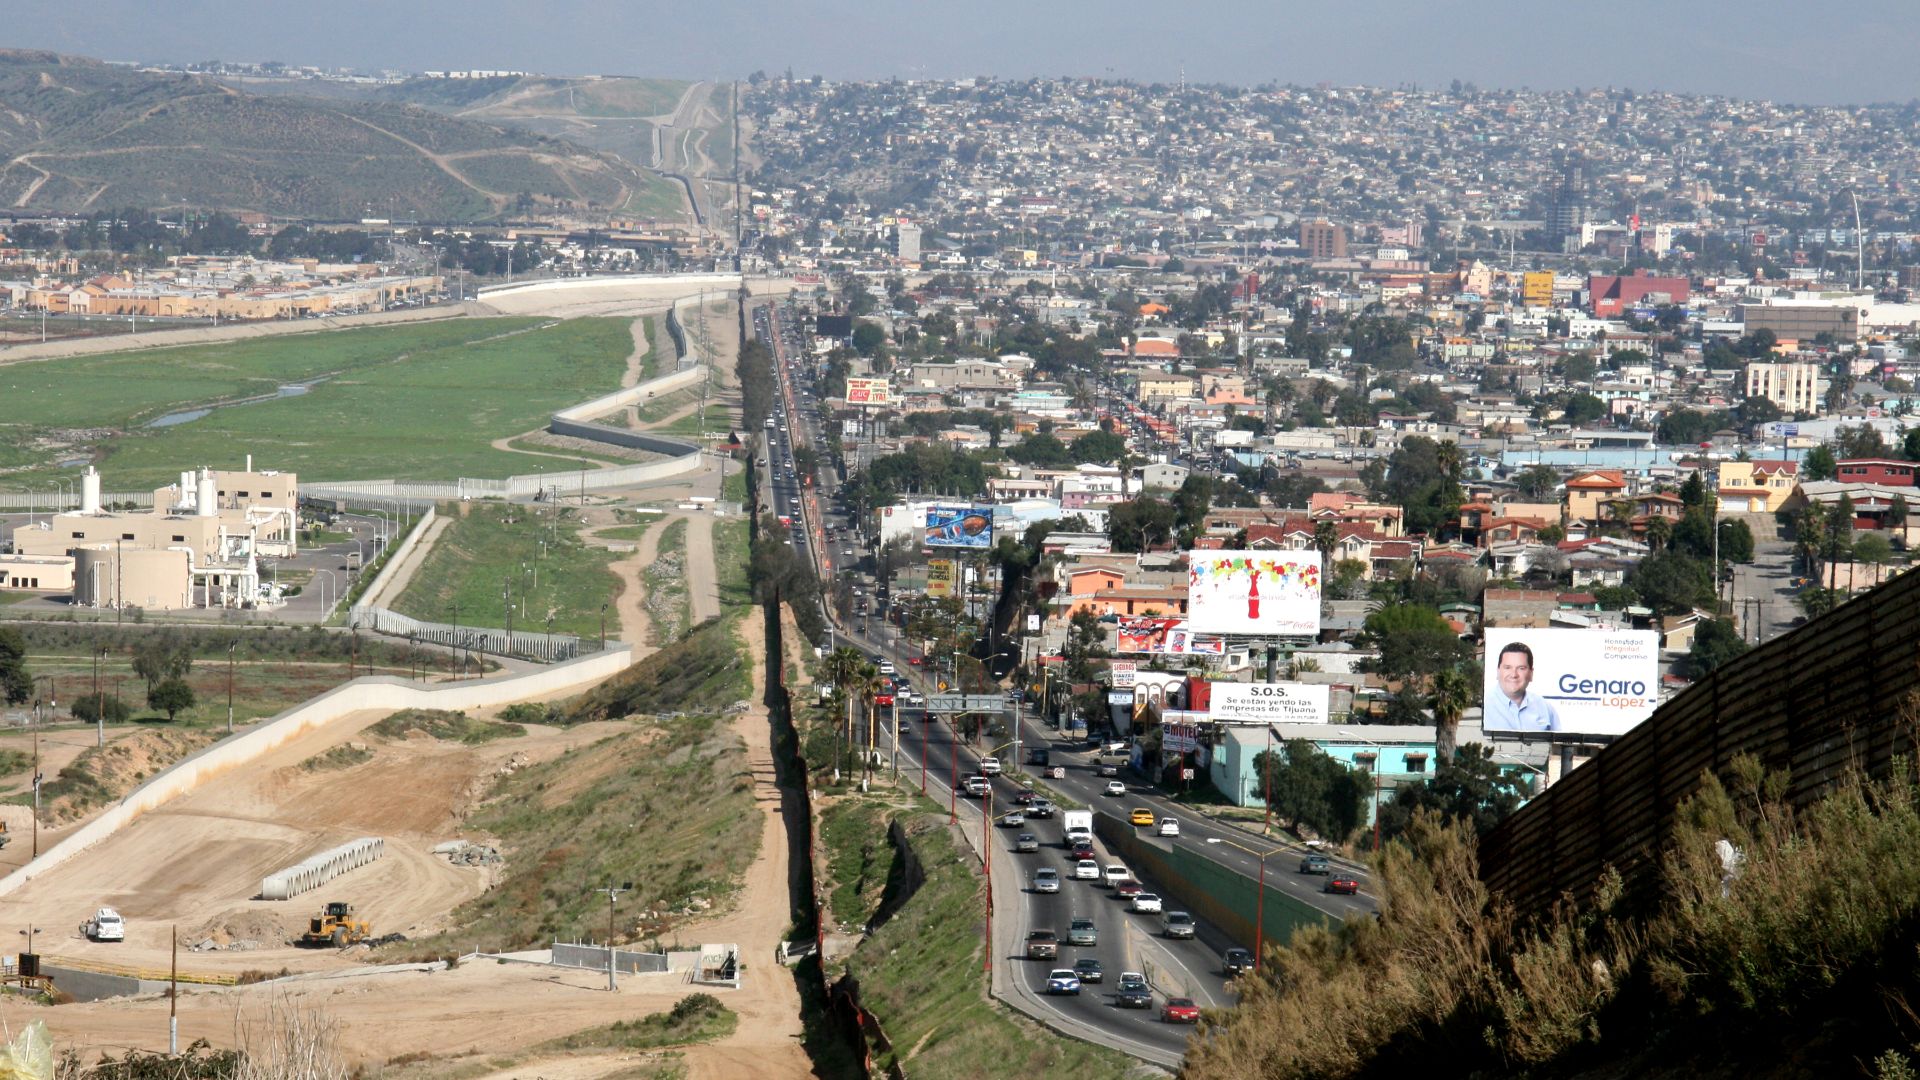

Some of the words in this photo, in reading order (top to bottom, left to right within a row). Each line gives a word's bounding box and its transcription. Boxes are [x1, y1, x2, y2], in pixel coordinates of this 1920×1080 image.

[1559, 674, 1646, 696] Genaro
[1250, 687, 1289, 697] S.O.S.
[1269, 699, 1296, 707] yendo
[1221, 705, 1266, 714] empresas
